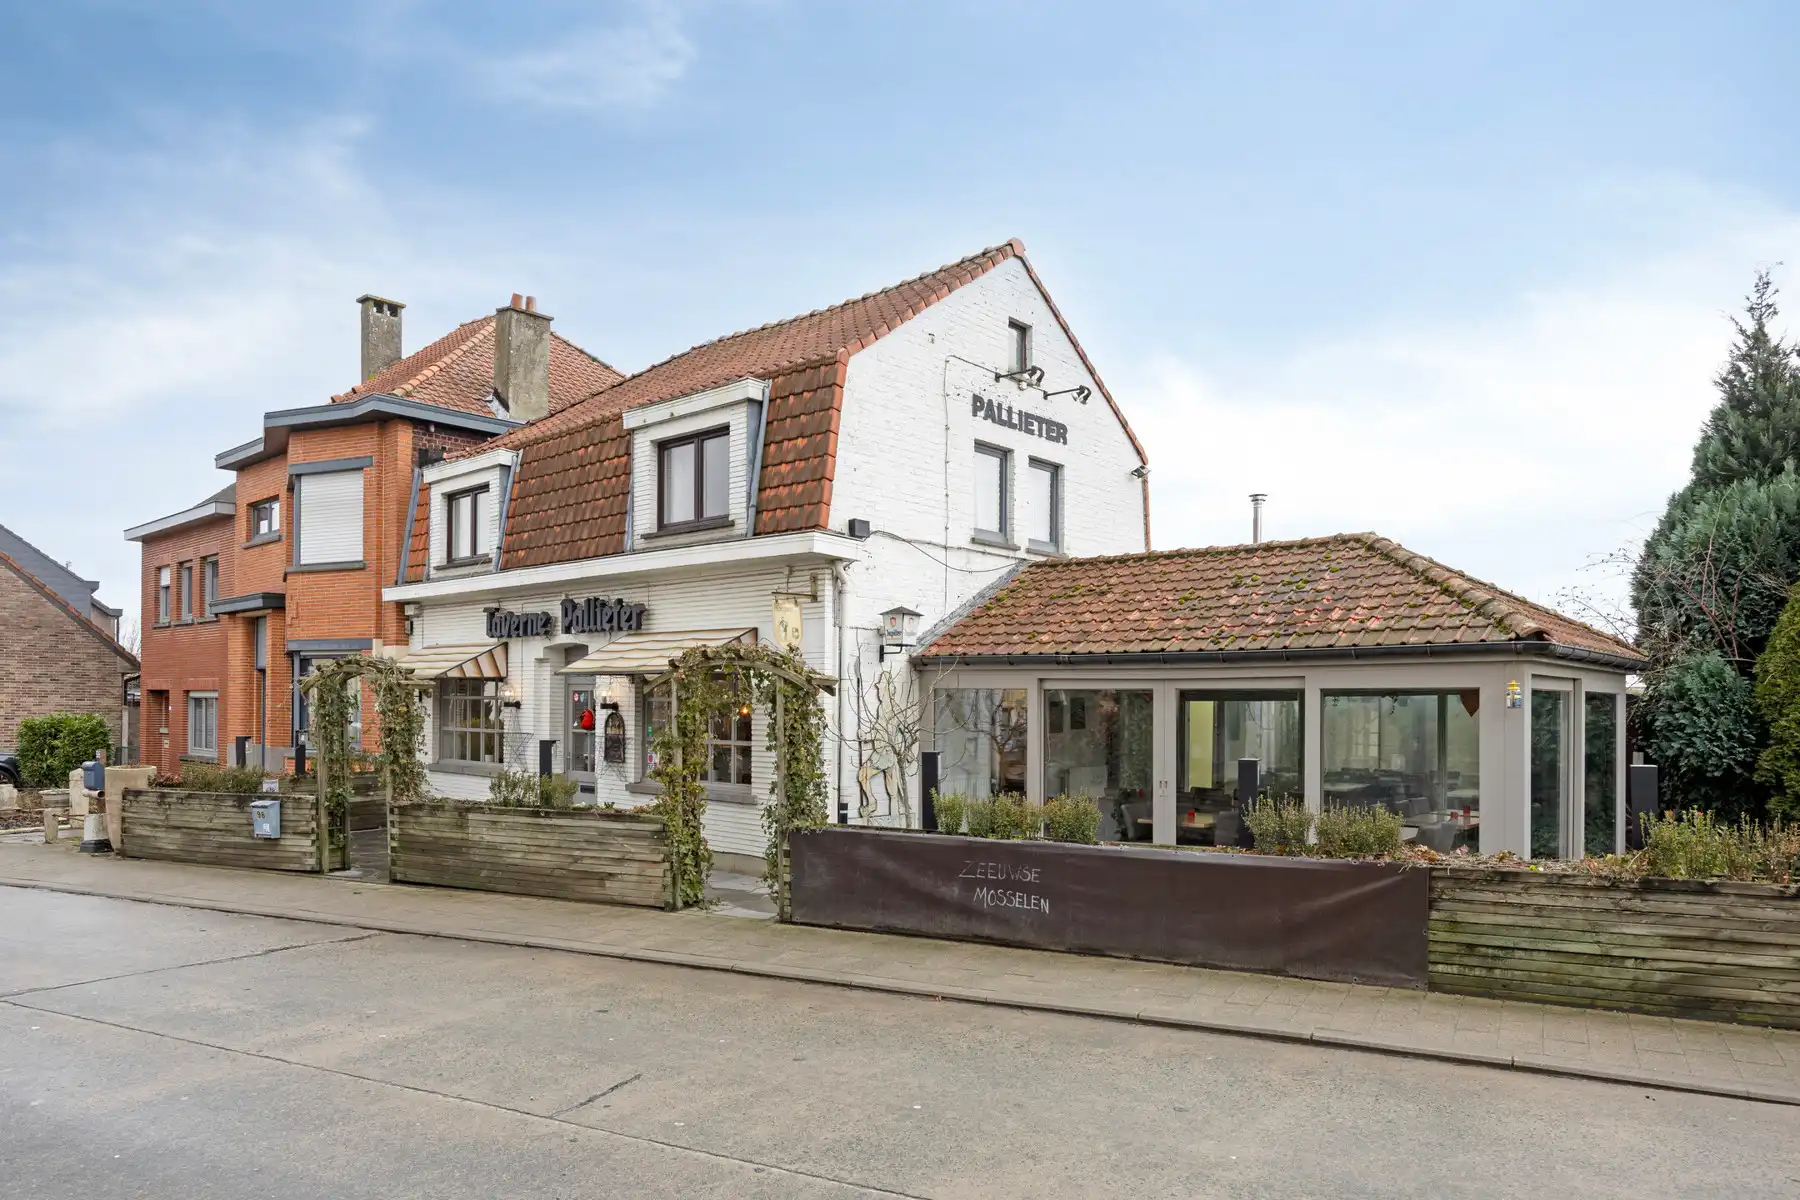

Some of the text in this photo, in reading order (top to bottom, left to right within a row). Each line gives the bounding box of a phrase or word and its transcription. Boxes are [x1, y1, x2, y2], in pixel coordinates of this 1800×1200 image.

[971, 393, 1068, 446] PALLIETER
[483, 598, 648, 638] Taverne Pallieter
[958, 860, 1041, 883] ZEEUWSE
[973, 886, 1050, 914] MOSSELEN
